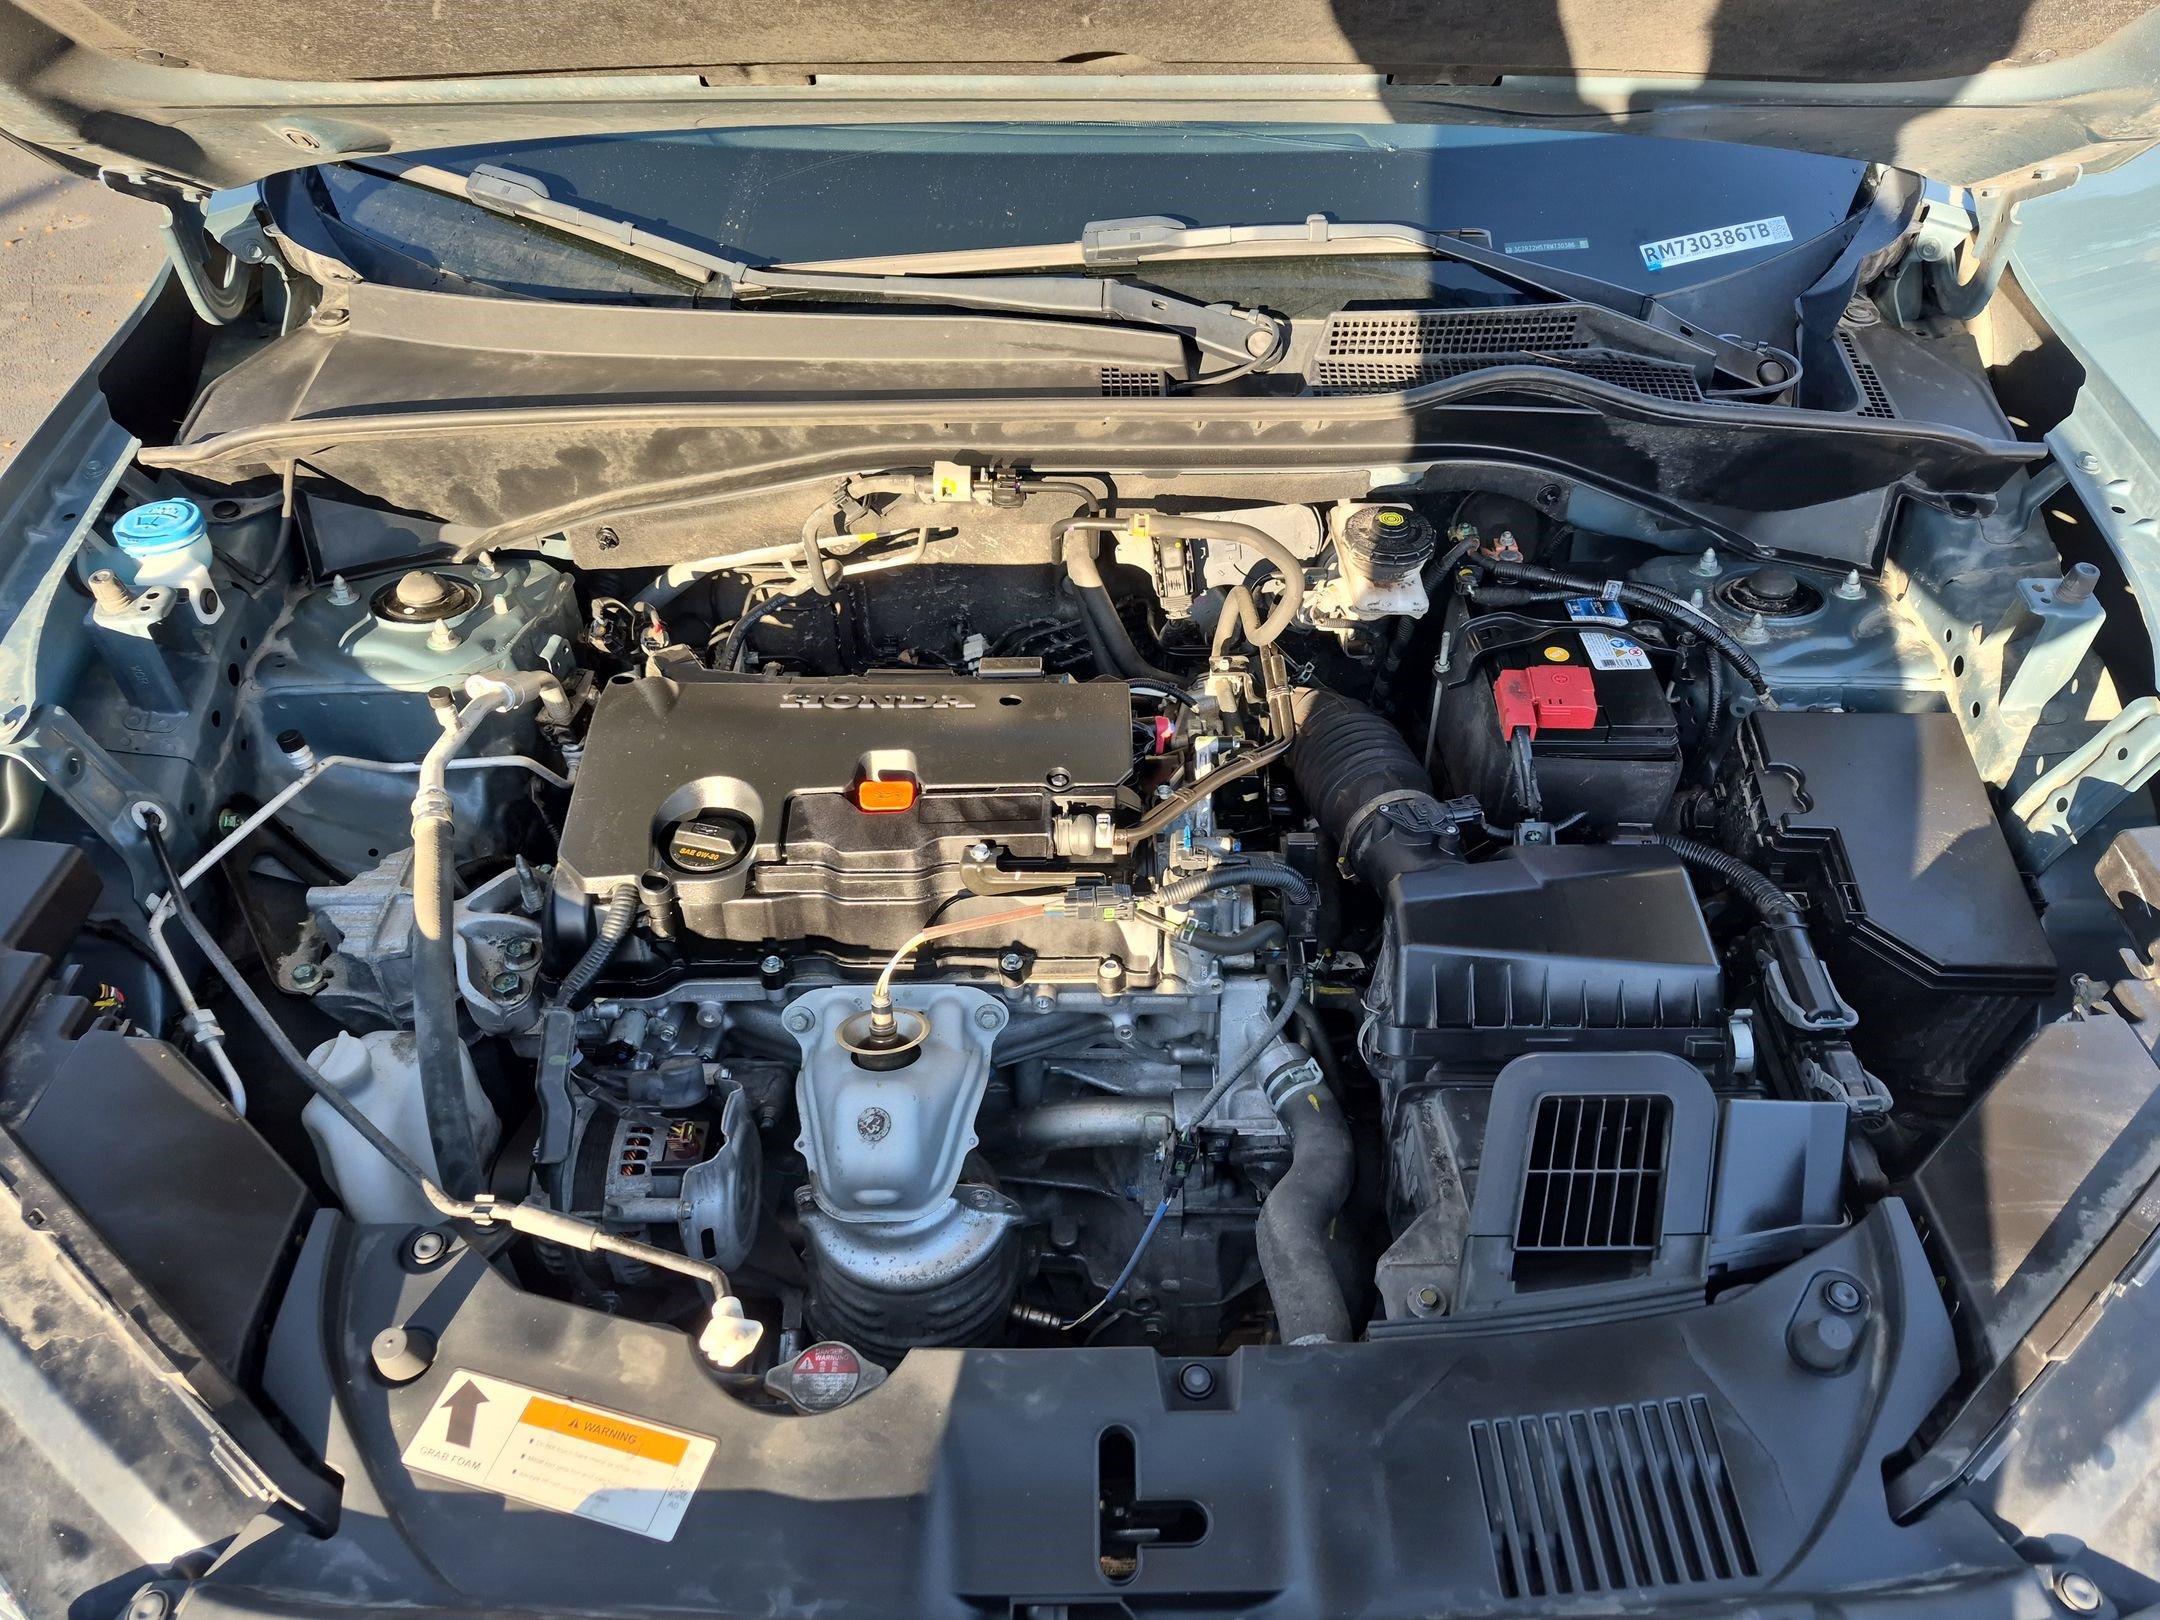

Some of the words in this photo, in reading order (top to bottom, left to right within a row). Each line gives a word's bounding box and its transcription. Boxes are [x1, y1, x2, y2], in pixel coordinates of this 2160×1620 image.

[1645, 223, 1770, 262] RM730386TB
[780, 694, 976, 709] HONDA
[679, 847, 697, 856] SAE
[696, 850, 720, 861] 0W-20
[584, 1421, 638, 1444] WARNING
[420, 1446, 449, 1461] GRAB
[451, 1454, 482, 1471] FOAM
